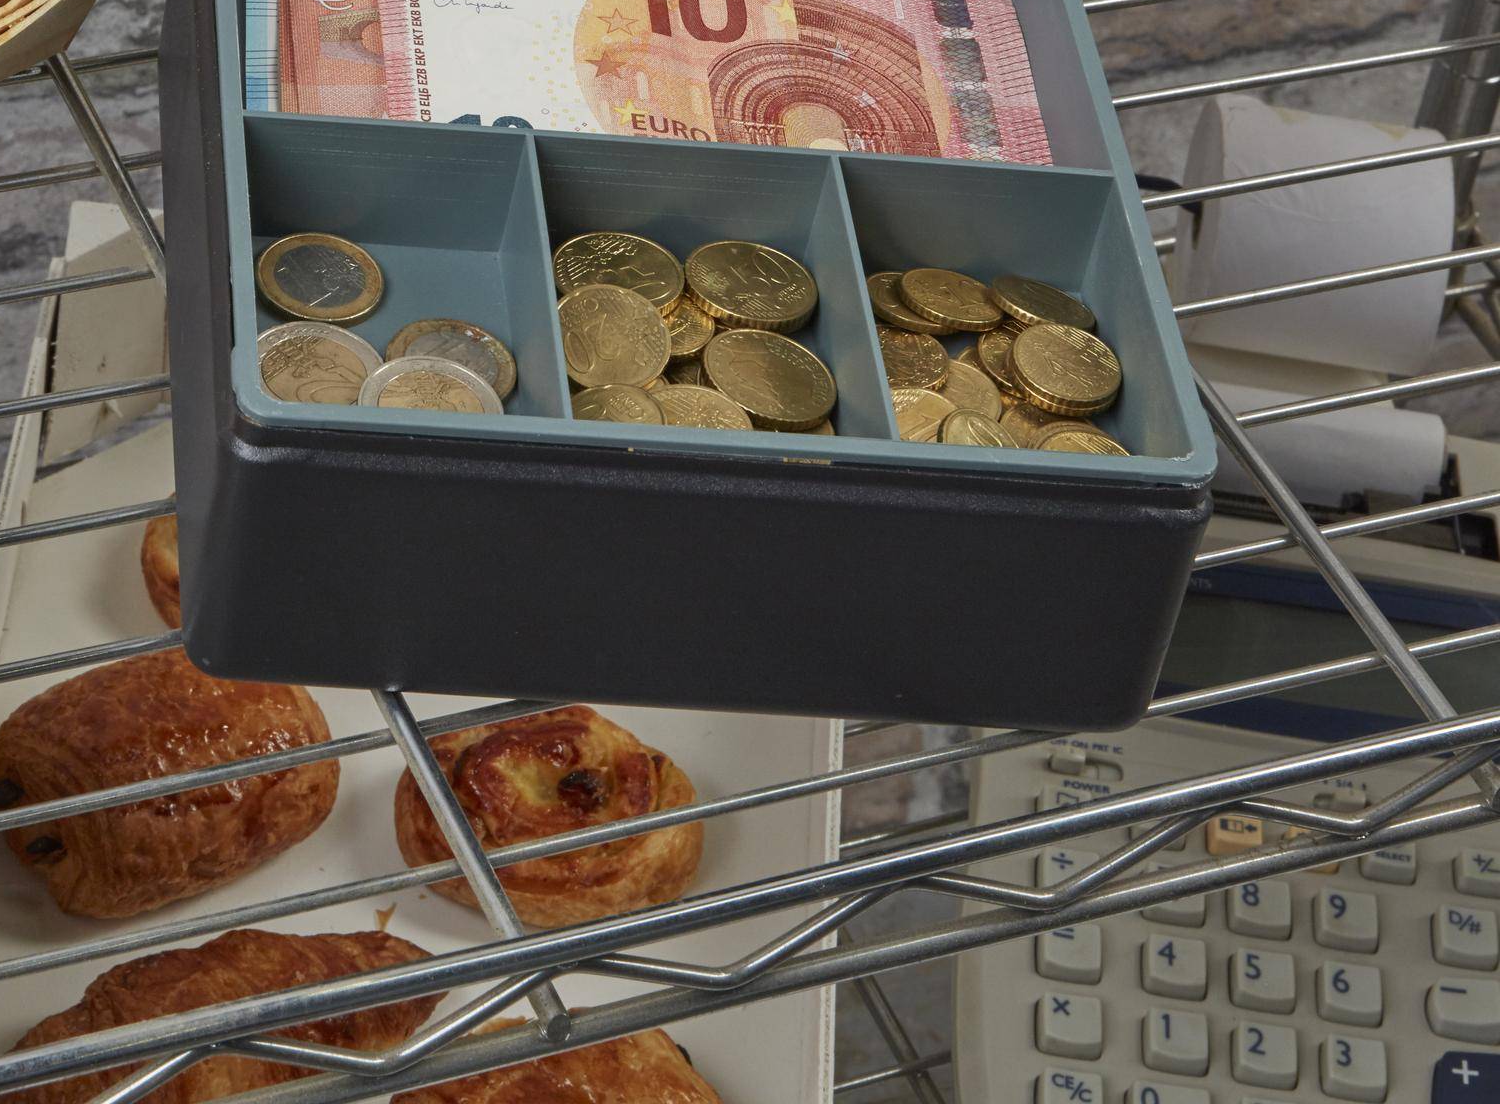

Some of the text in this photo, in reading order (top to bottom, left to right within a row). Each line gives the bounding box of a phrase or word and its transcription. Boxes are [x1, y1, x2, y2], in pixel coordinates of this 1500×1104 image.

[414, 48, 426, 67] EKP
[416, 67, 428, 86] EZB
[421, 107, 432, 122] CB
[631, 112, 711, 142] EURO
[1063, 779, 1110, 794] POWER
[1241, 882, 1260, 907] 8
[1328, 893, 1347, 919] 9
[1157, 940, 1176, 967] 4
[1244, 953, 1262, 981] 5
[1331, 968, 1350, 994] 6
[1161, 1013, 1171, 1040] 1
[1247, 1026, 1266, 1056] 2
[1335, 1039, 1352, 1068] 3
[1051, 1072, 1093, 1104] CE/C
